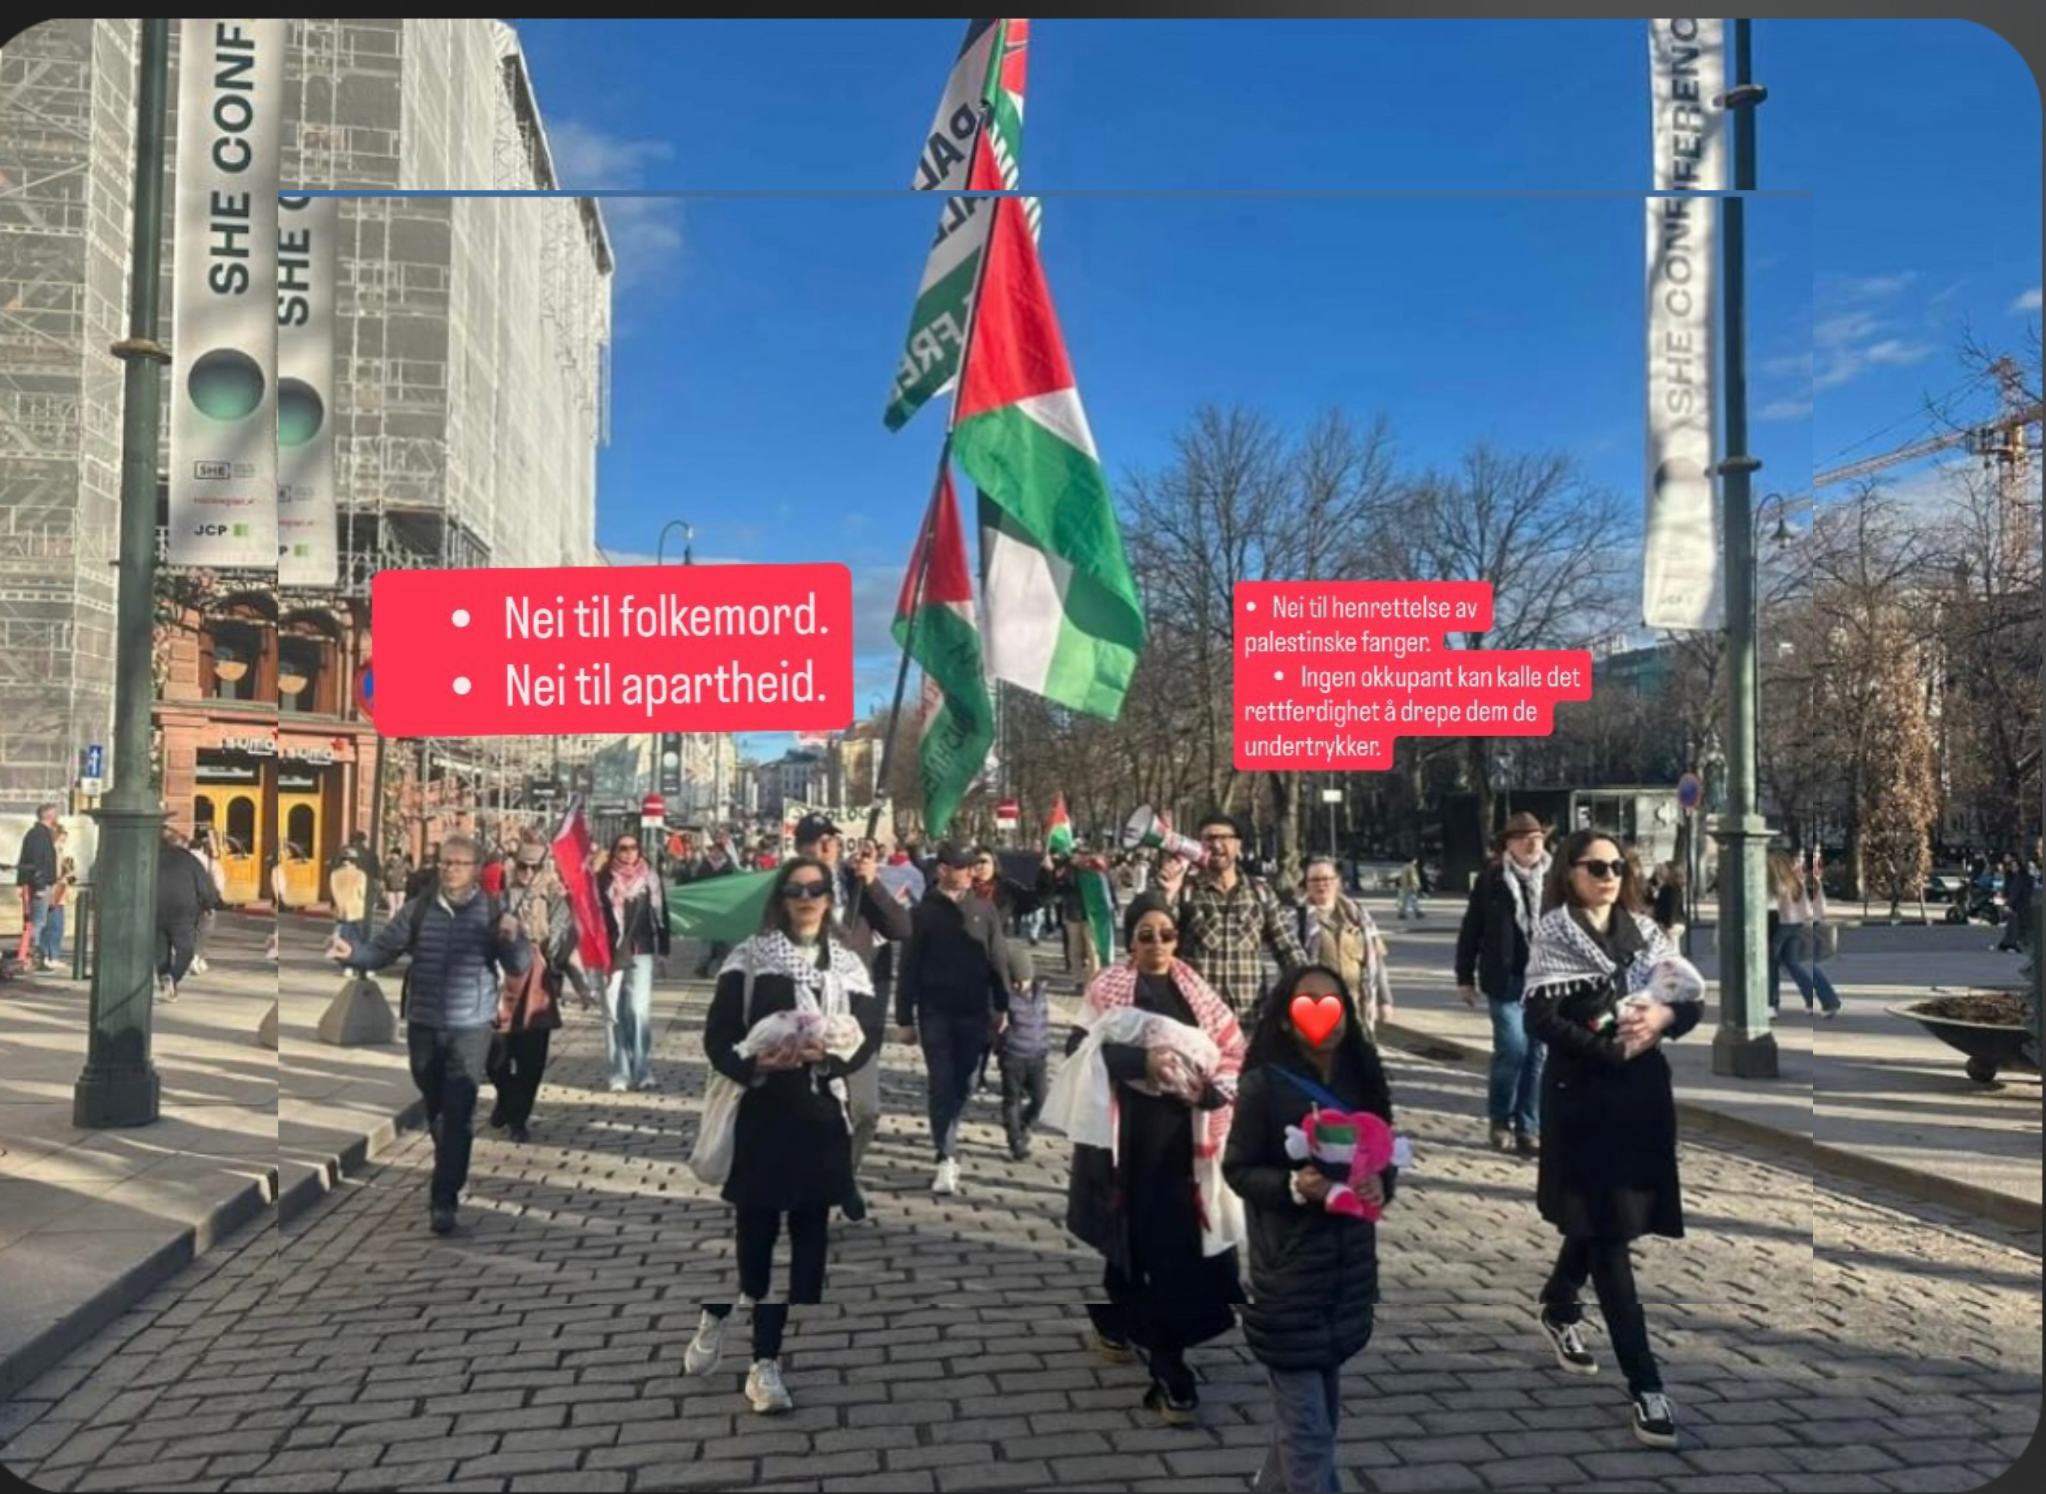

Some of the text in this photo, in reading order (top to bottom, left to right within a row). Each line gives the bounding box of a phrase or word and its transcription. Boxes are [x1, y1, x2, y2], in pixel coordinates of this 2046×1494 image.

[208, 190, 250, 294] SHE
[1666, 331, 1693, 414] SHE
[193, 524, 228, 536] JCP
